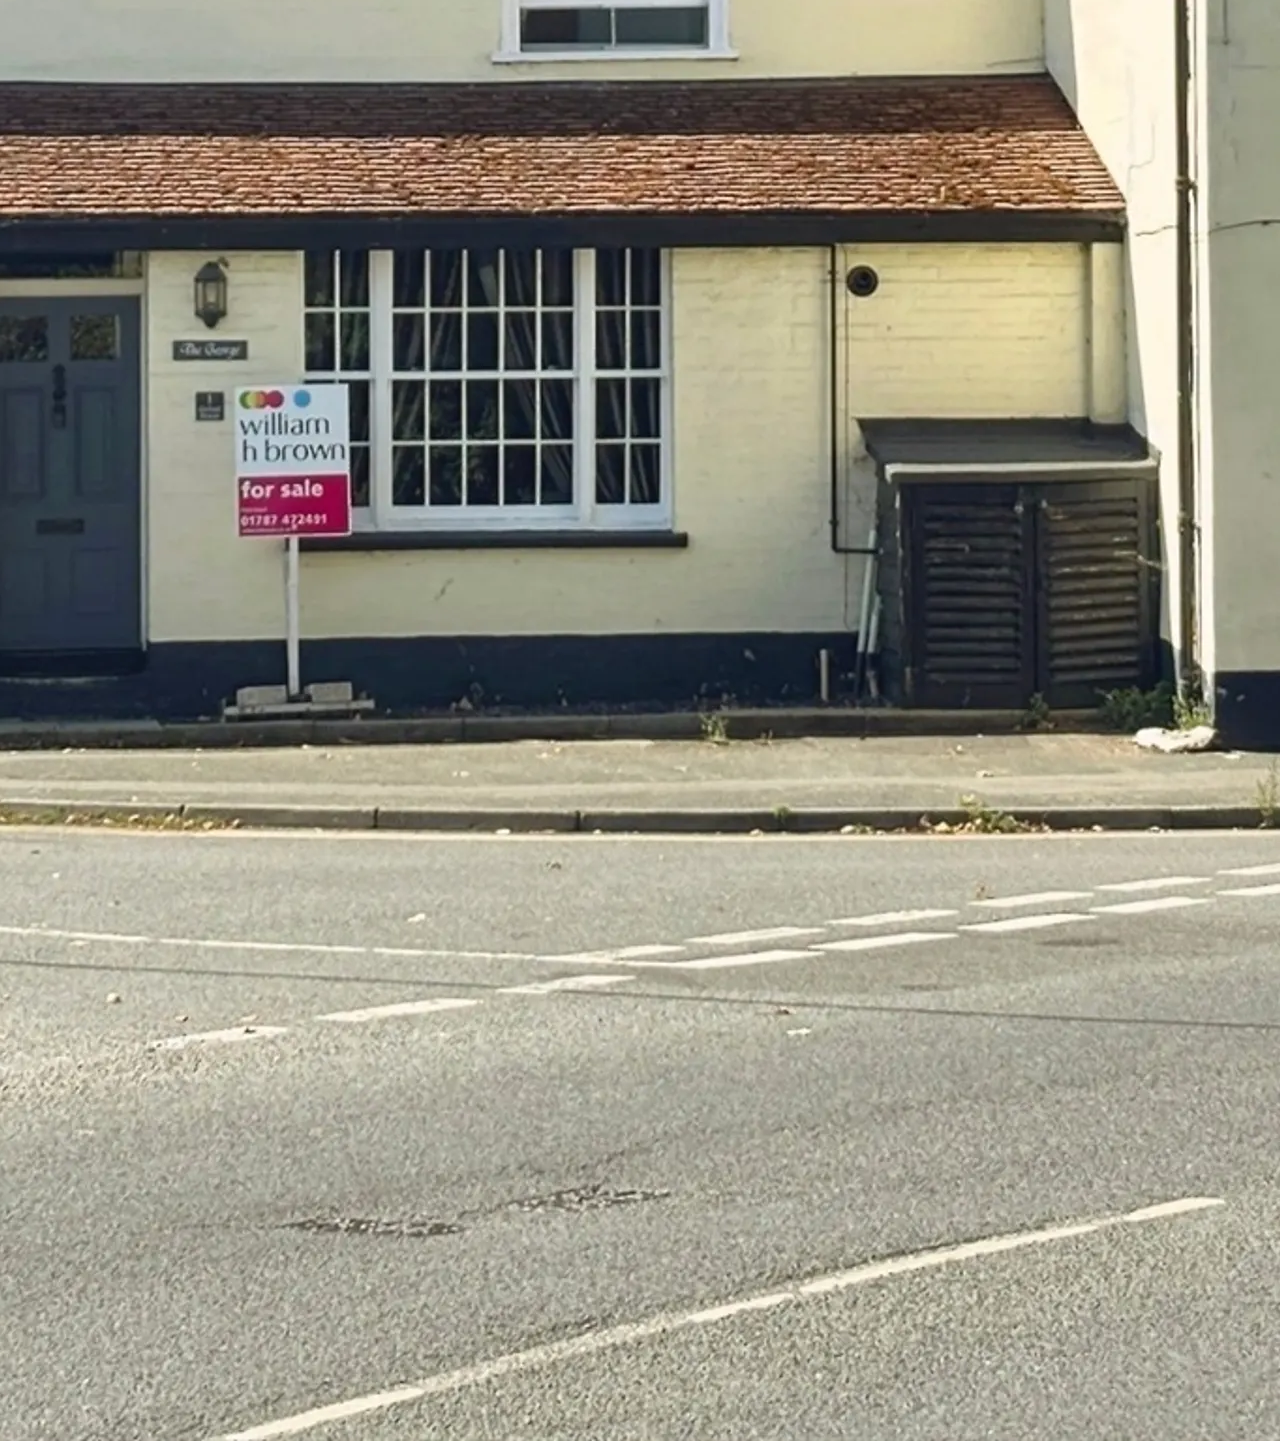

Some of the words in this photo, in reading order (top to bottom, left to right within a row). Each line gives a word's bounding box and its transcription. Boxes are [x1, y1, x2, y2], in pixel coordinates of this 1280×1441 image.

[239, 412, 329, 436] william
[243, 438, 257, 462] h
[264, 438, 345, 462] brown
[241, 480, 275, 498] for
[280, 478, 324, 498] sale
[241, 514, 278, 527] 01787
